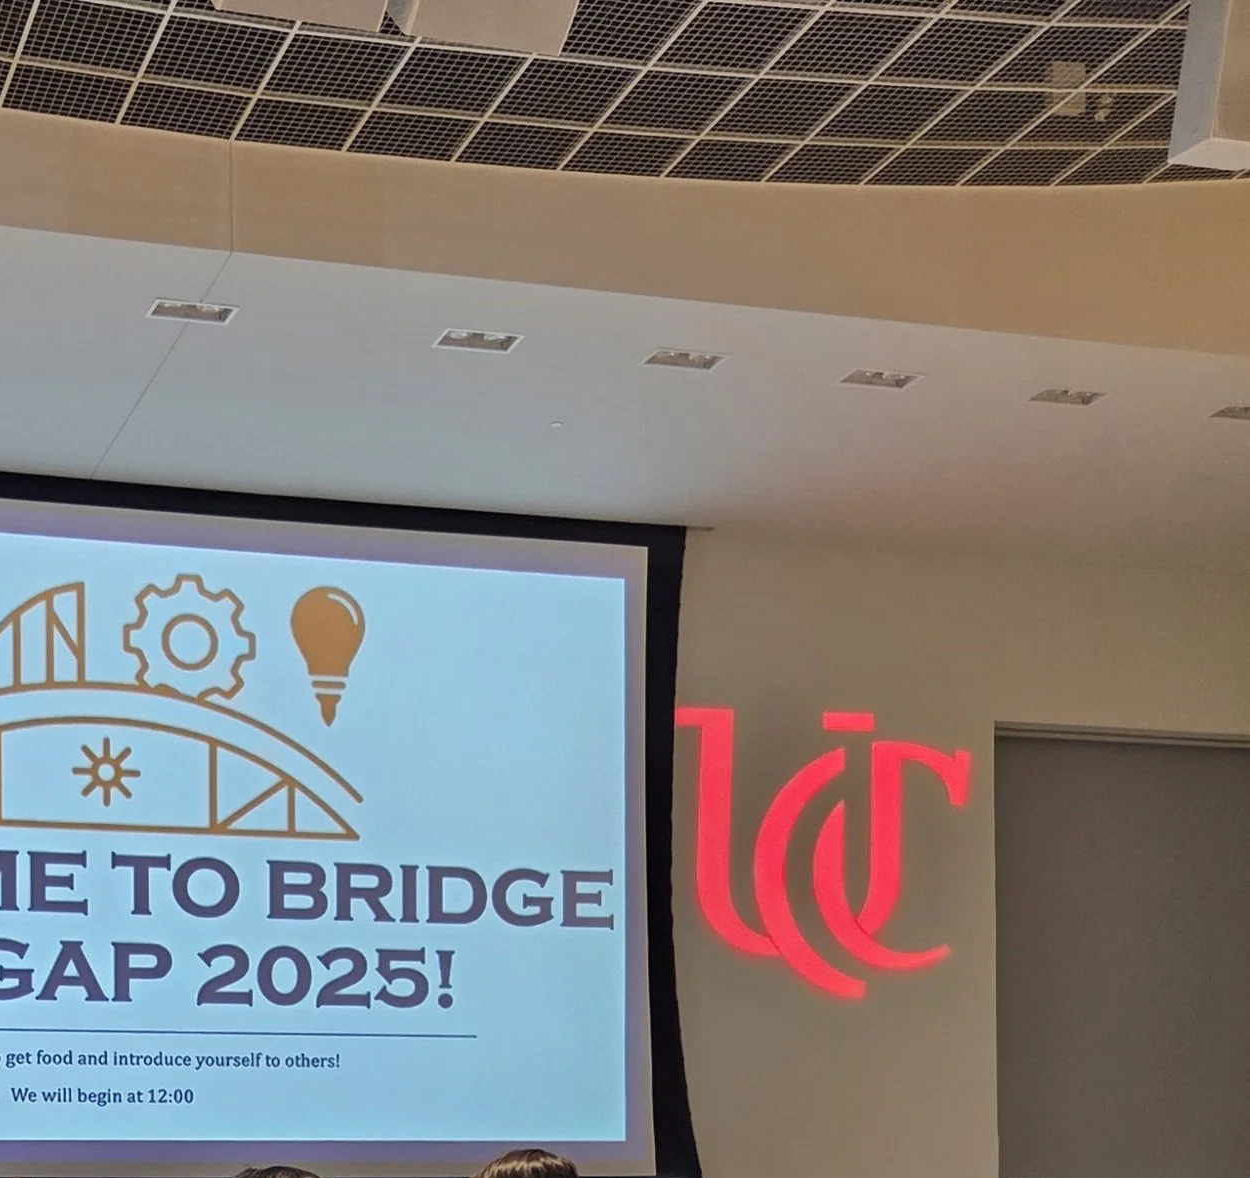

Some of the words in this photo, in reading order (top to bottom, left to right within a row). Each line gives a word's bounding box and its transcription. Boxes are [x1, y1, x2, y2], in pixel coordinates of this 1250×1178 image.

[111, 852, 239, 917] TO
[267, 860, 614, 930] BRIDGE
[197, 944, 456, 1009] 2025!
[5, 1051, 33, 1069] get
[36, 1049, 73, 1066] food
[77, 1051, 109, 1067] and
[113, 1051, 192, 1067] introduce
[195, 1052, 262, 1070] yourself
[265, 1054, 281, 1068] to
[284, 1052, 340, 1069] others!
[10, 1087, 38, 1103] We
[41, 1087, 73, 1103] will
[77, 1087, 123, 1108] begin
[126, 1090, 144, 1104] at
[147, 1088, 194, 1104] 12:00
